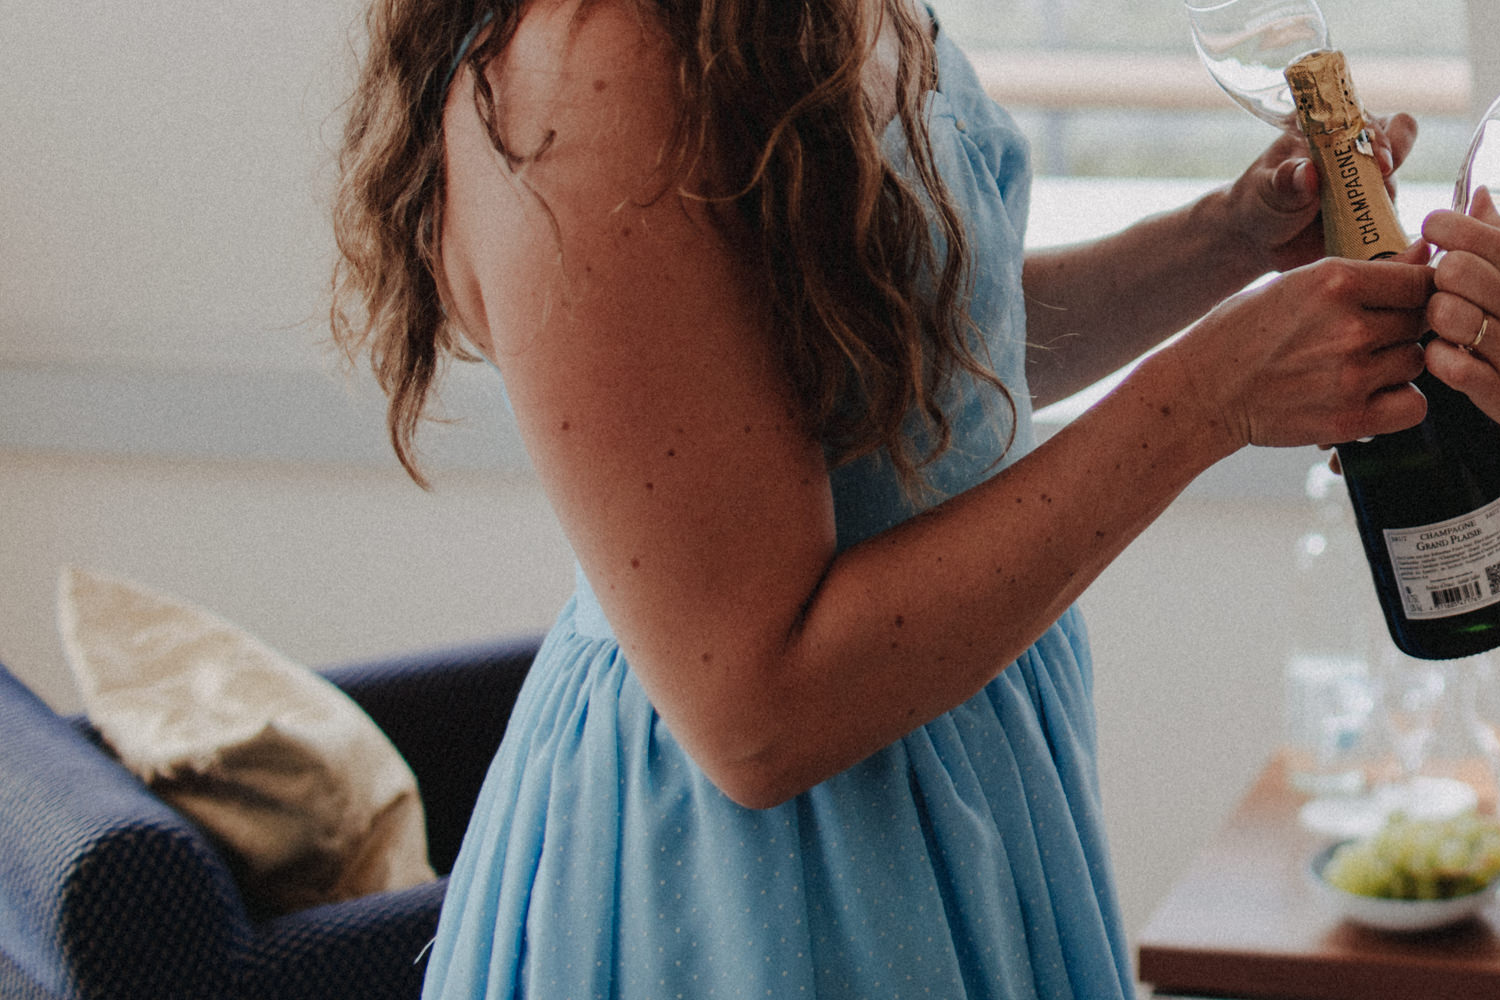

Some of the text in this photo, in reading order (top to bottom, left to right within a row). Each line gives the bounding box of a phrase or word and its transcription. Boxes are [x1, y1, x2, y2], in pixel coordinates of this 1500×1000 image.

[1334, 145, 1380, 245] CHAMPAGNE
[1416, 528, 1483, 551] GRAND PLAISIR
[1419, 521, 1477, 540] CHAMPAGNE
